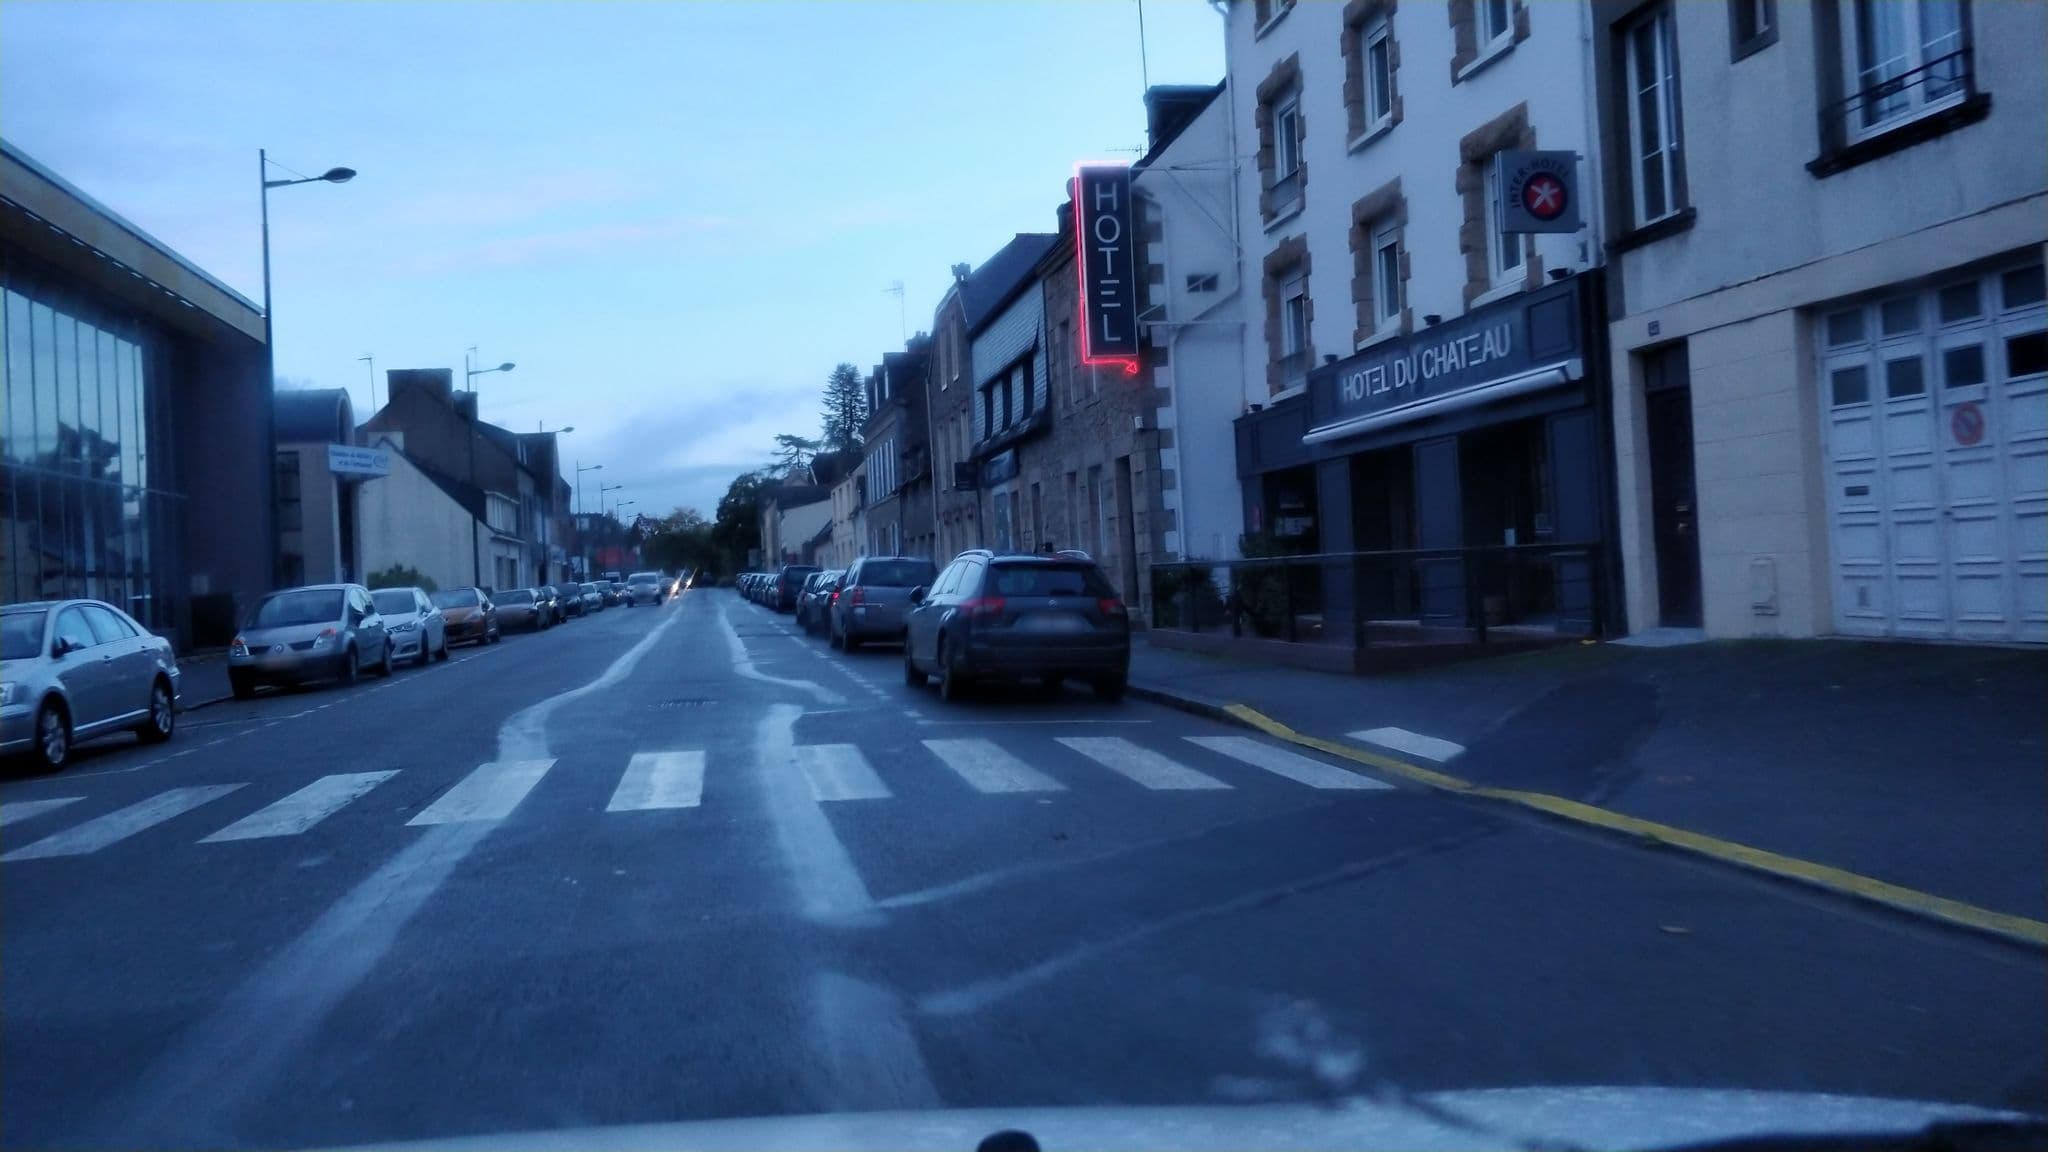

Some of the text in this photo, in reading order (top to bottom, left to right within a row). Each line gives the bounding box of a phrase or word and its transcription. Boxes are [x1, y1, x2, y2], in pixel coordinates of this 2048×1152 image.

[1095, 183, 1121, 341] HOTEL
[1343, 323, 1510, 401] HOTEL DU CHATEAU
